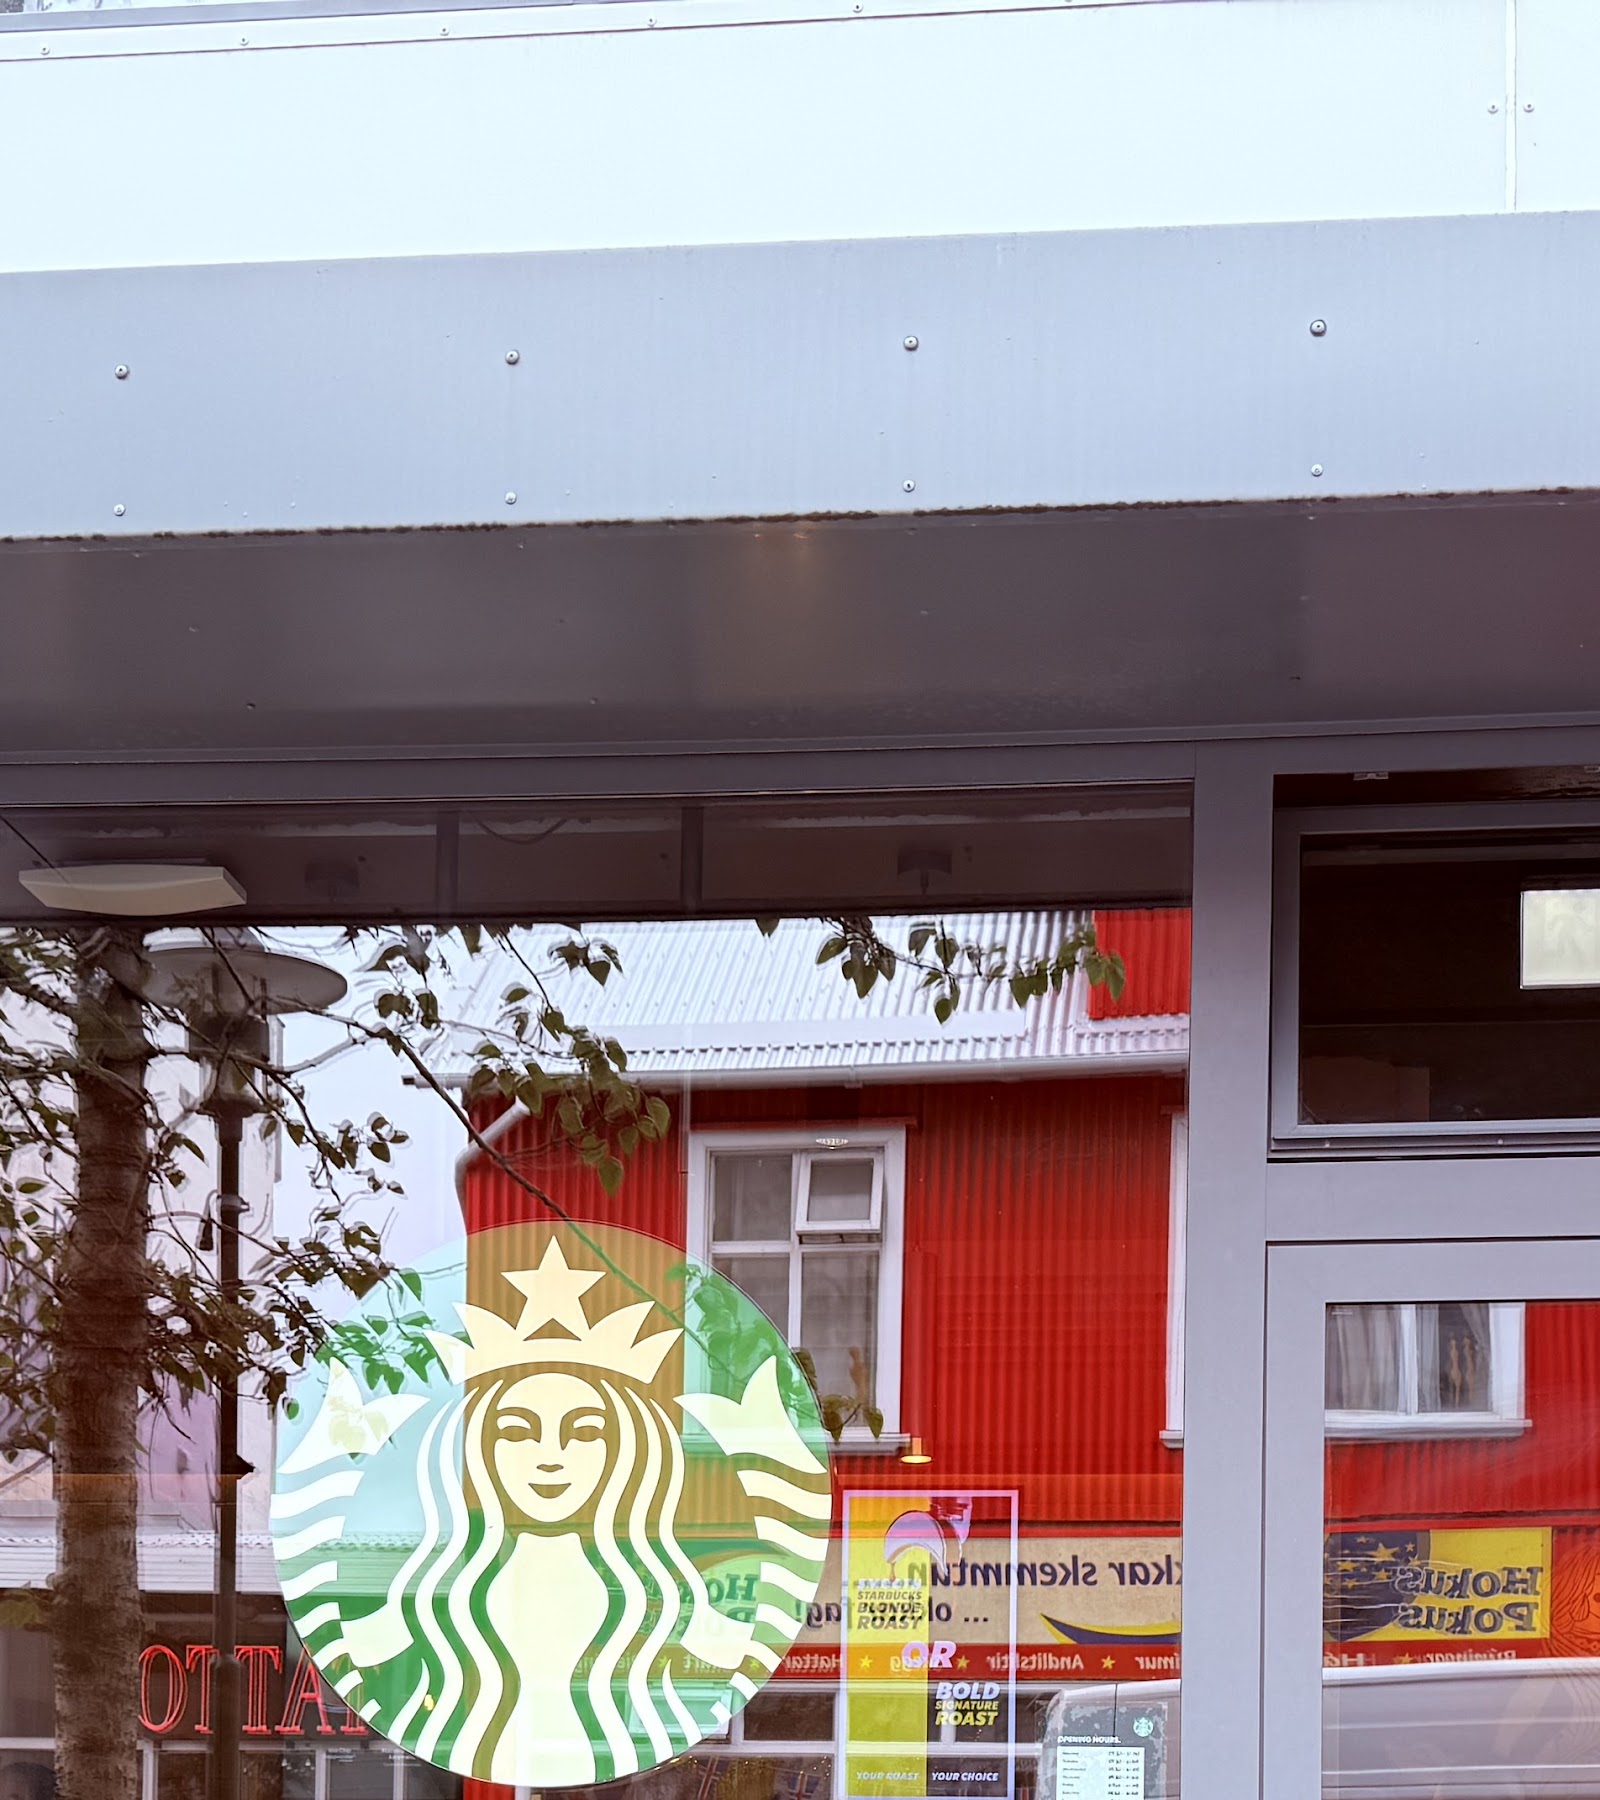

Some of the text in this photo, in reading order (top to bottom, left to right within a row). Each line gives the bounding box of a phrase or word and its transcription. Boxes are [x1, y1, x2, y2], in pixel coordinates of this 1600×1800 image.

[857, 1590, 922, 1601] STARBUCKS
[857, 1602, 922, 1614] BLONDE
[857, 1615, 922, 1630] ROAST
[902, 1641, 956, 1668] OR
[936, 1682, 1001, 1700] BOLD
[935, 1700, 1000, 1711] SIGNATURE
[935, 1711, 999, 1726] ROAST
[931, 1772, 999, 1781] YOUR CHOICE
